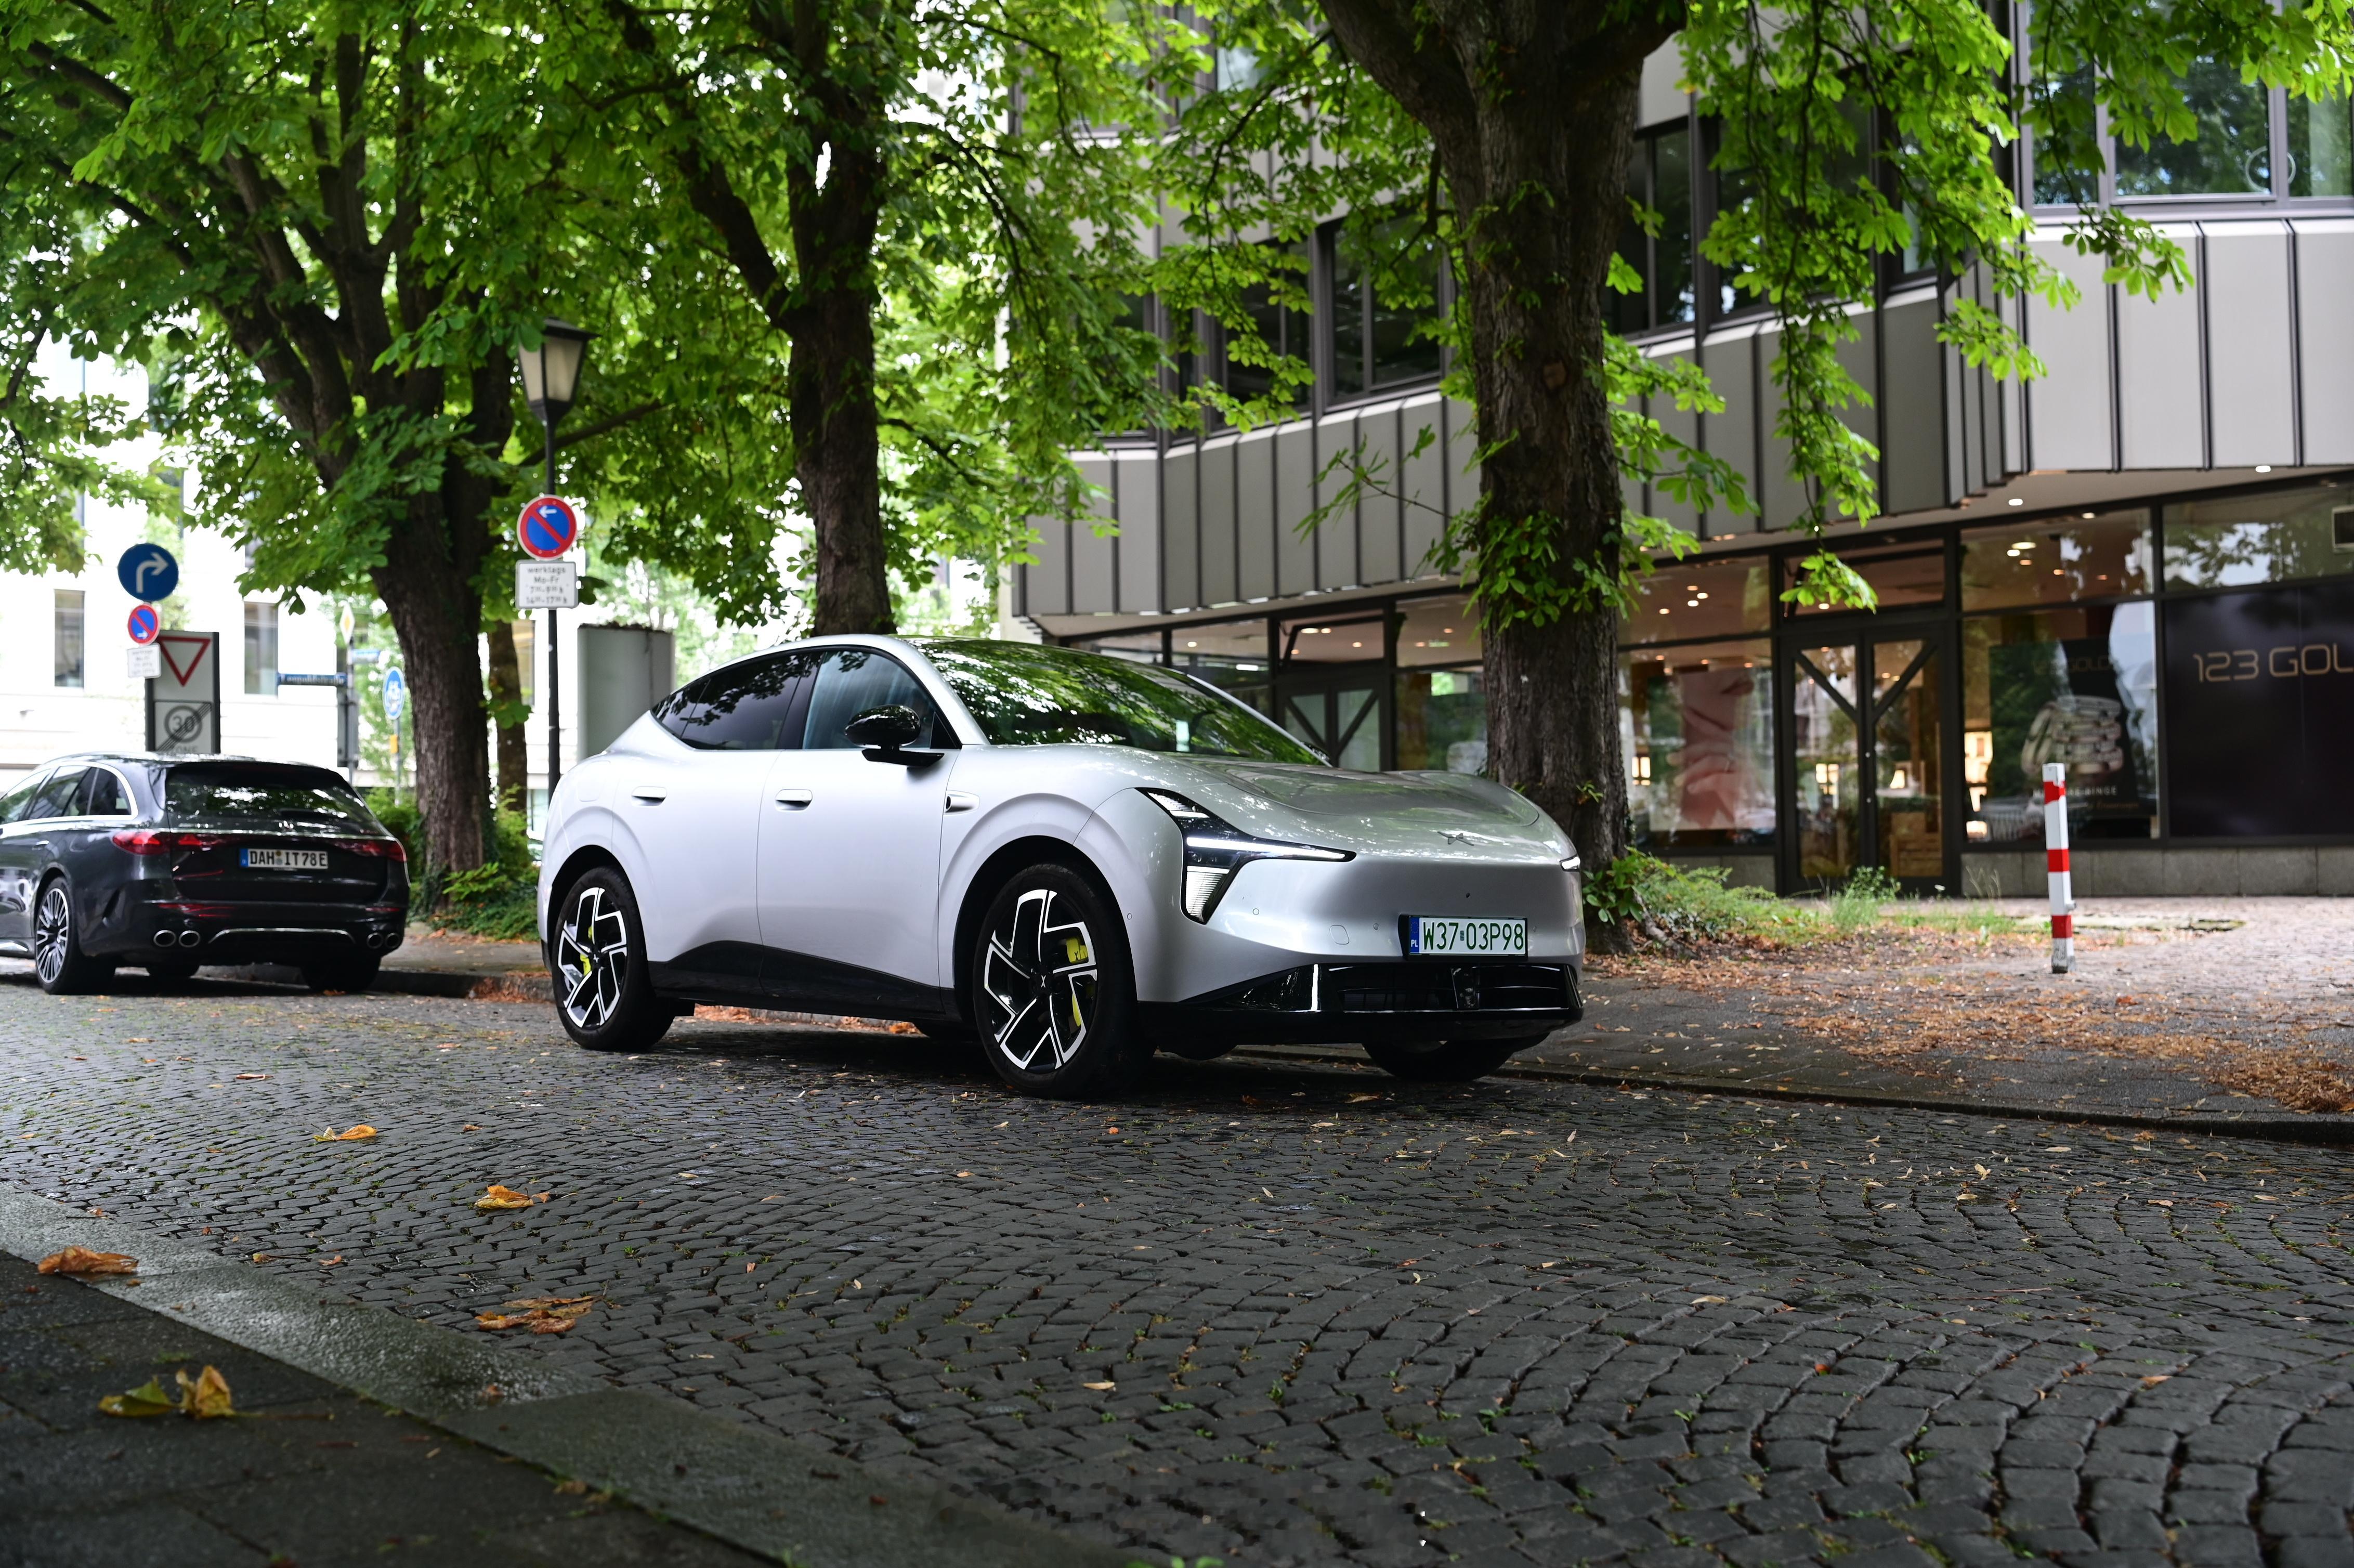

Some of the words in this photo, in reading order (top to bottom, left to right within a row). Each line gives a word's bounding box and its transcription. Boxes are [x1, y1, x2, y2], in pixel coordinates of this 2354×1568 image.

[528, 566, 566, 575] werktags
[2192, 650, 2259, 683] 123
[249, 851, 274, 865] DAH
[1410, 939, 1418, 948] PL
